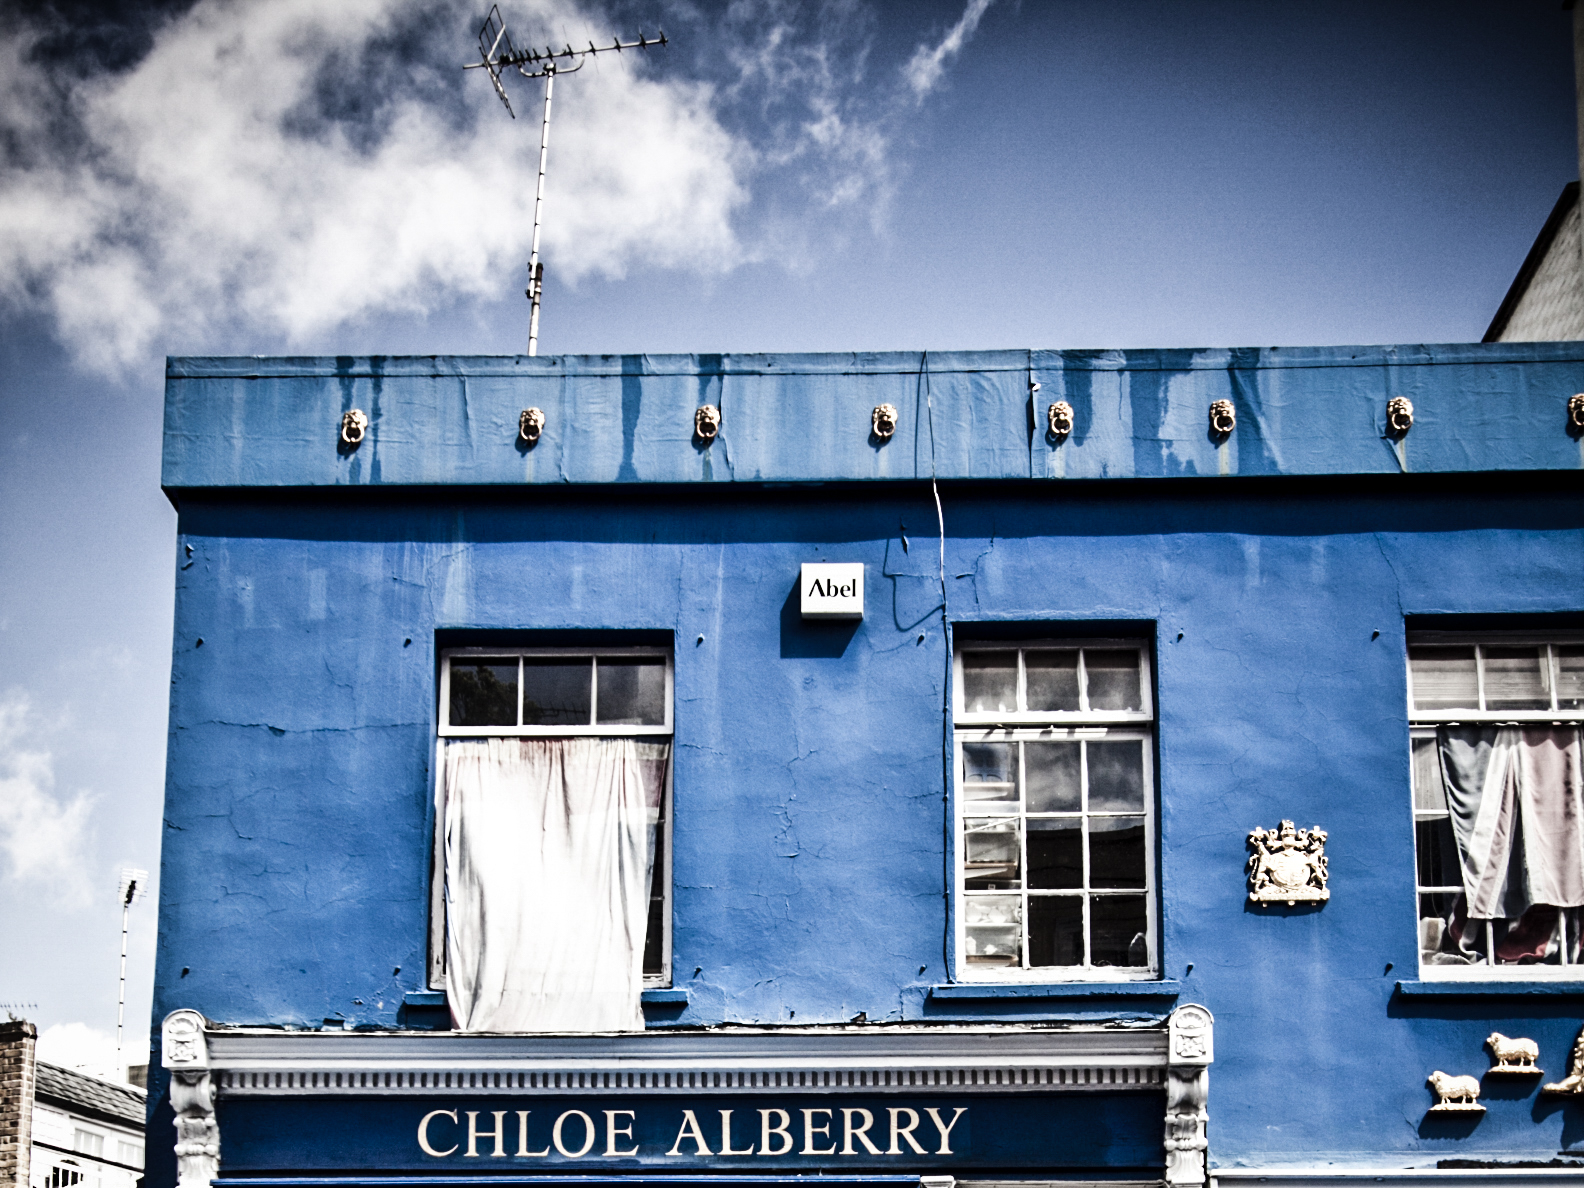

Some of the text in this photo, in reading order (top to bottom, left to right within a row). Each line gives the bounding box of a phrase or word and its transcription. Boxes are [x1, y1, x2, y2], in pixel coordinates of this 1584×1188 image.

[808, 578, 856, 598] Abel
[417, 1107, 968, 1158] CHLOE ALBERRY
